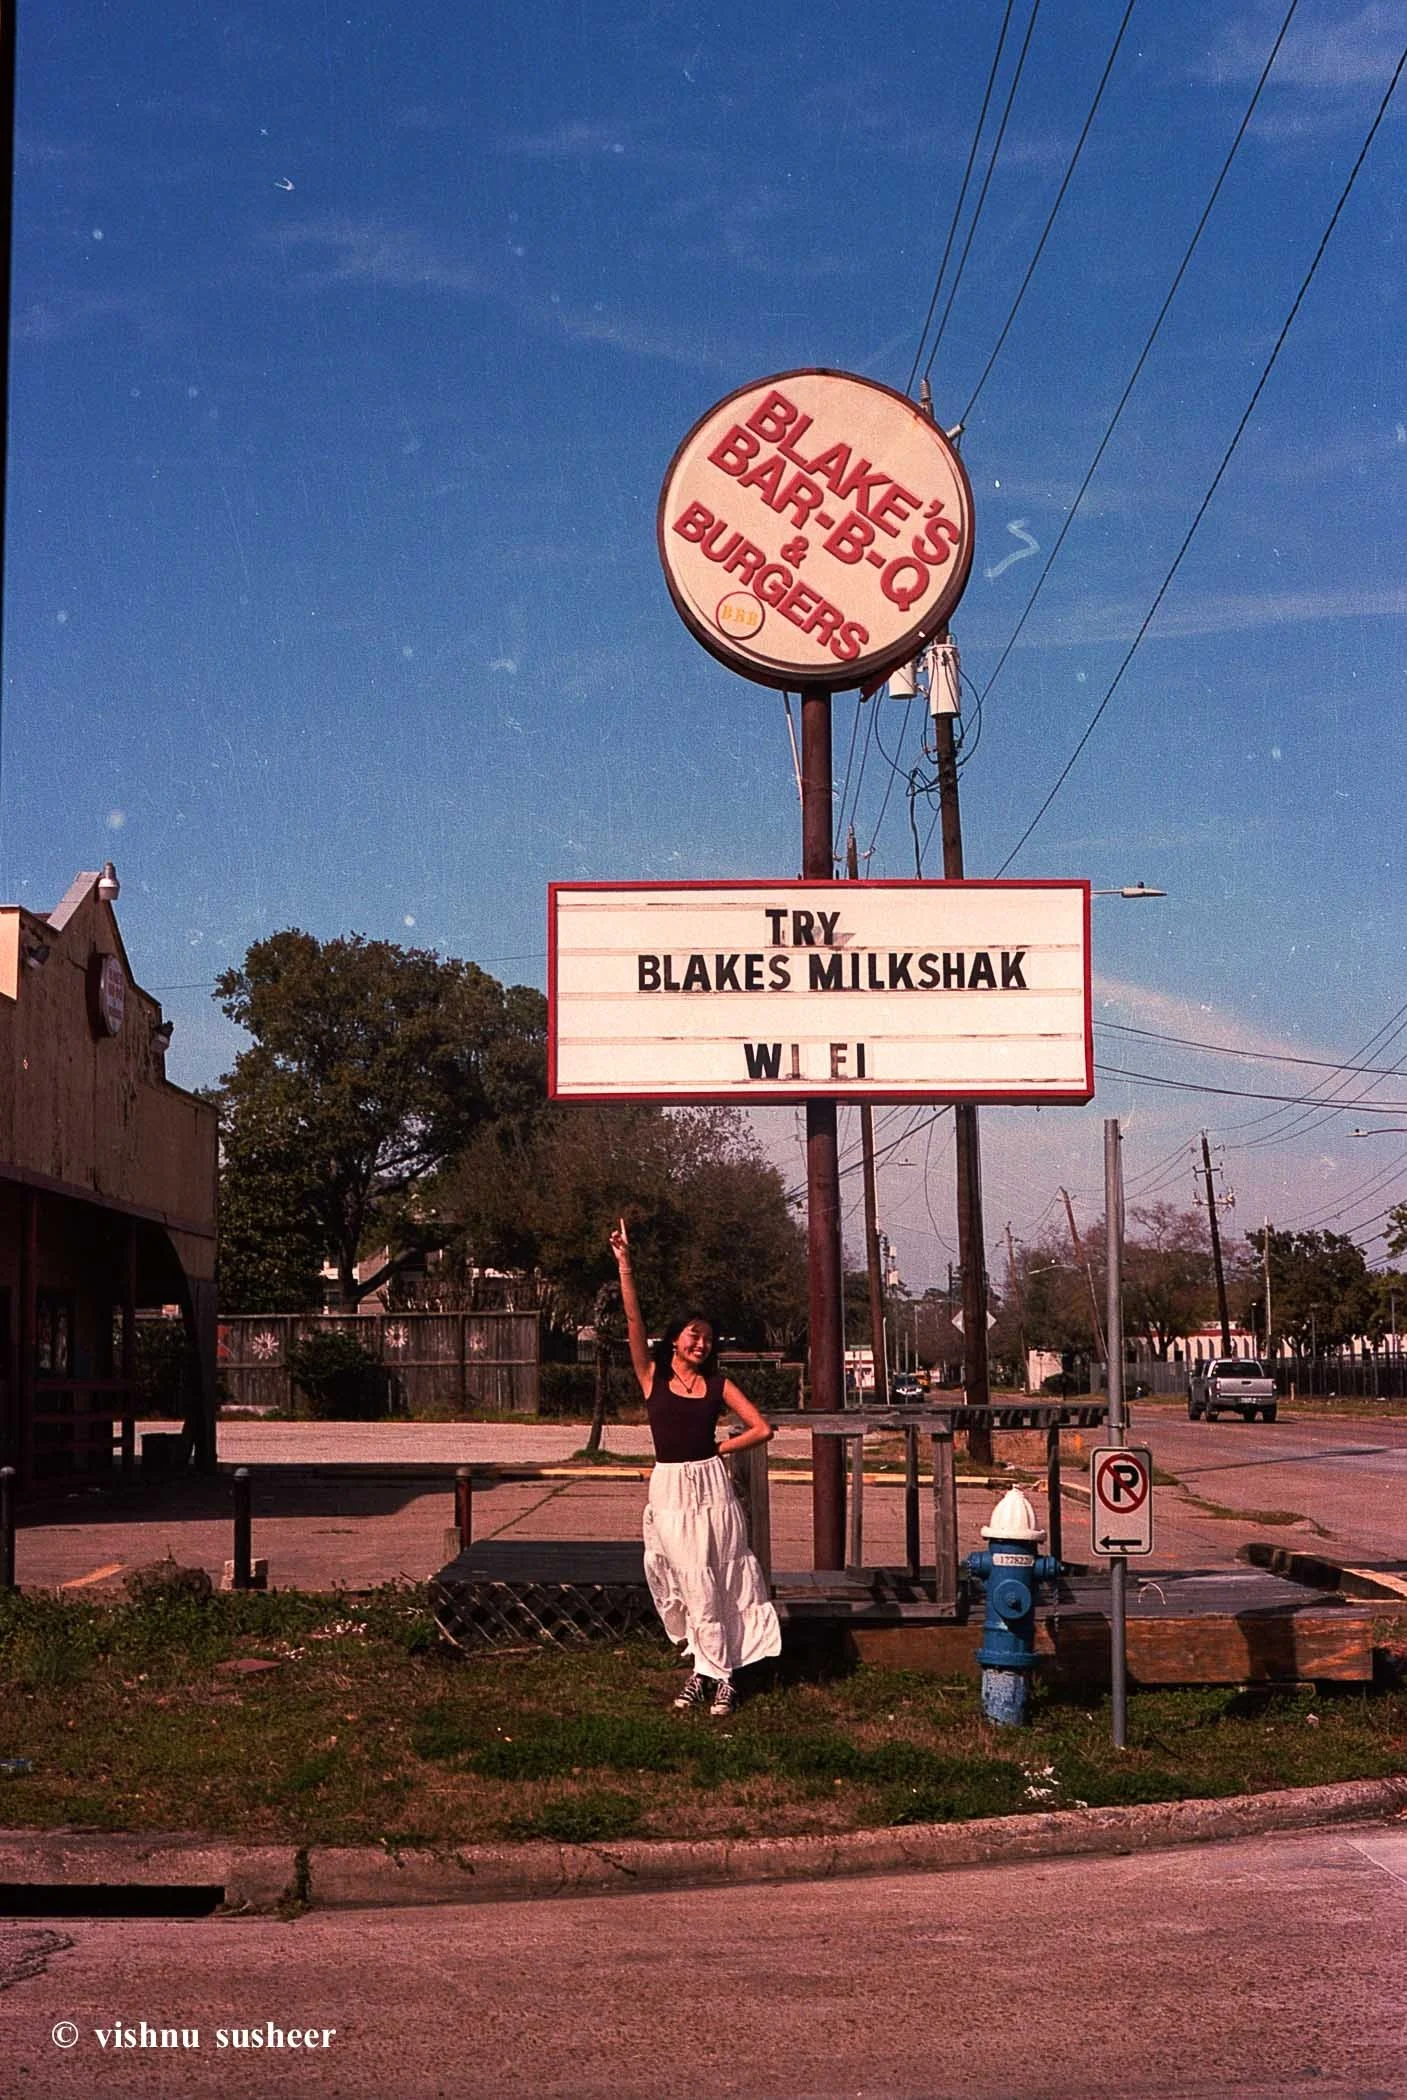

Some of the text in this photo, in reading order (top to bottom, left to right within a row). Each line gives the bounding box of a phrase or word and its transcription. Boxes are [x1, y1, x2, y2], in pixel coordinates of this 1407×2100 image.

[745, 390, 961, 566] BLAKE'S
[707, 424, 930, 612] BAR-B-Q
[780, 536, 810, 568] &
[672, 500, 869, 661] BURGERS
[765, 909, 841, 946] TRY
[638, 952, 1027, 991] BLAKES MILKSHAK
[1113, 1465, 1139, 1502] P
